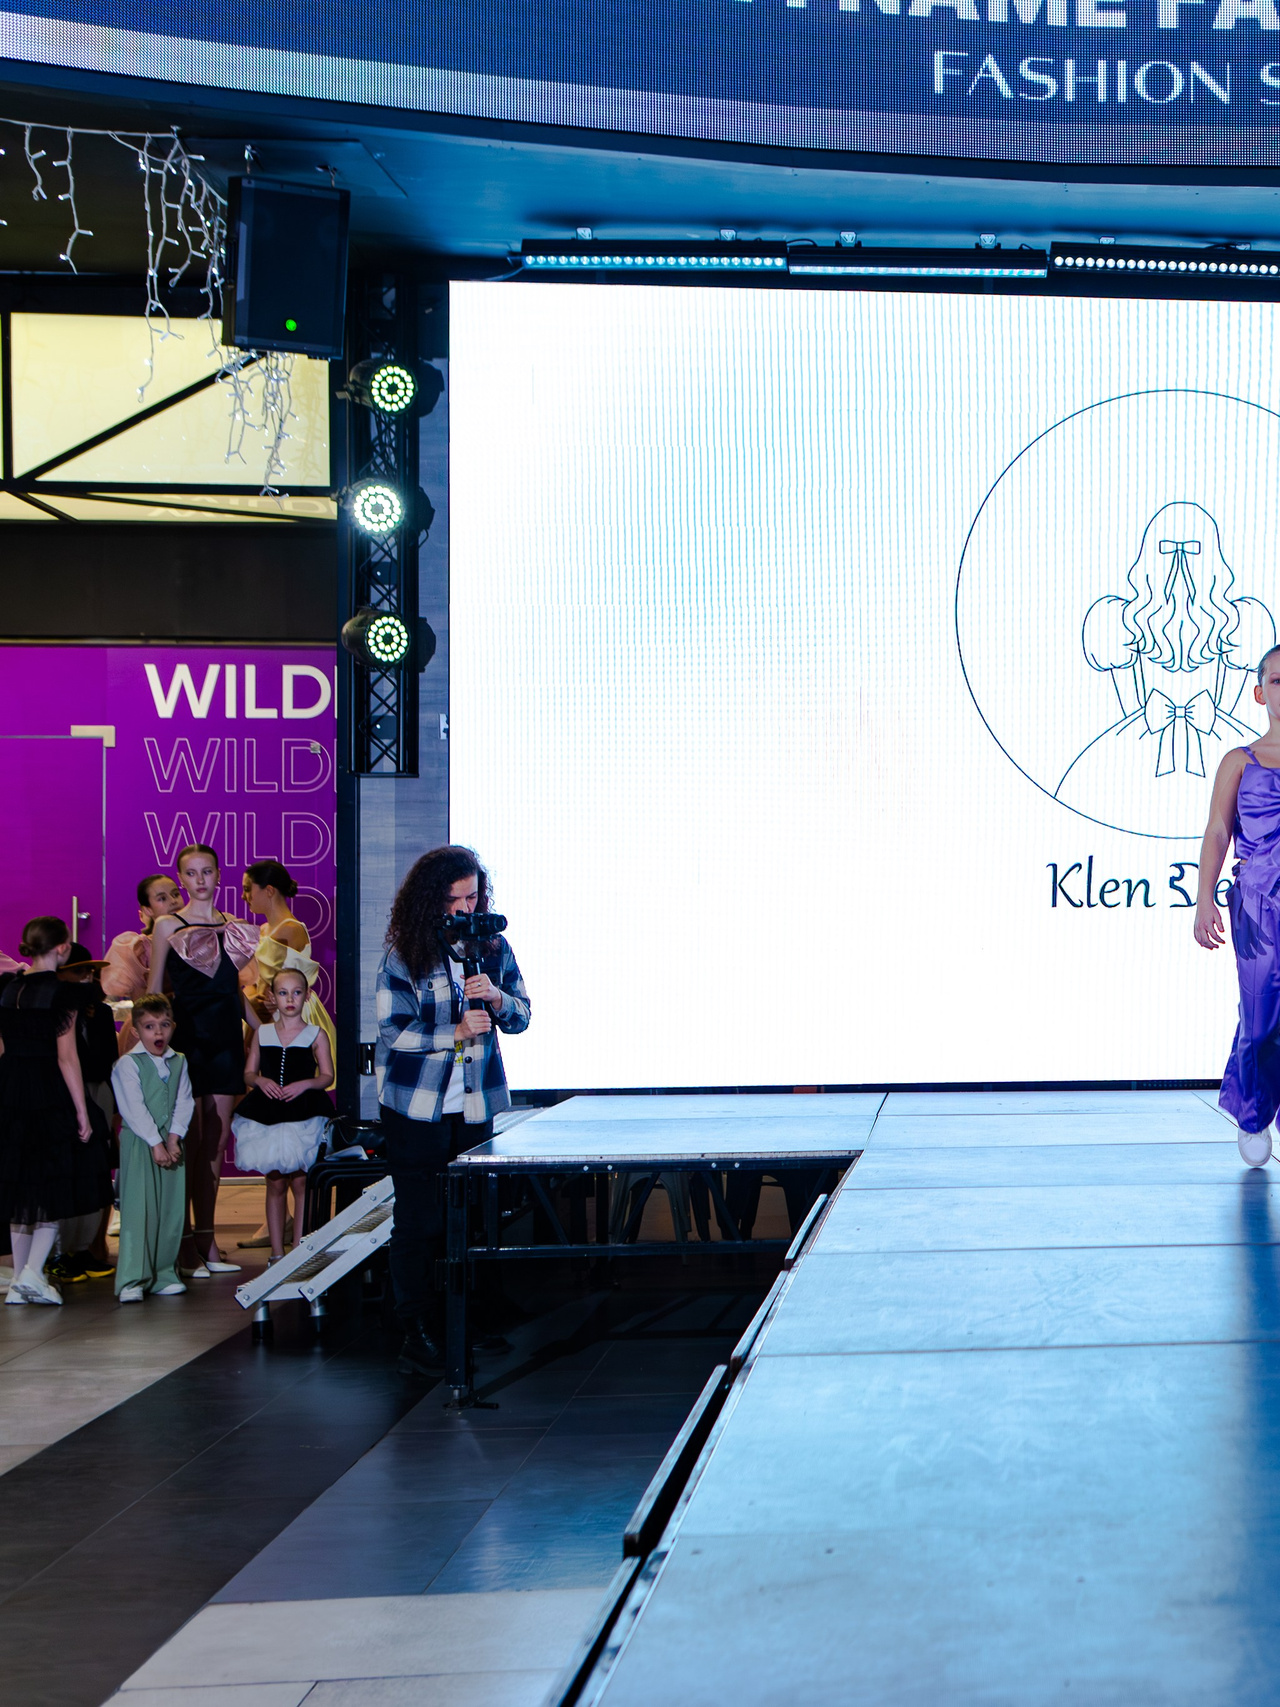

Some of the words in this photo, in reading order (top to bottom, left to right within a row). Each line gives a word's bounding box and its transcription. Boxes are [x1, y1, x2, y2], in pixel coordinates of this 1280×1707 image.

[934, 50, 1231, 104] FASHION
[144, 663, 337, 719] WILD
[144, 737, 337, 793] WILD
[144, 812, 337, 867] WILD
[1046, 855, 1156, 909] Klen
